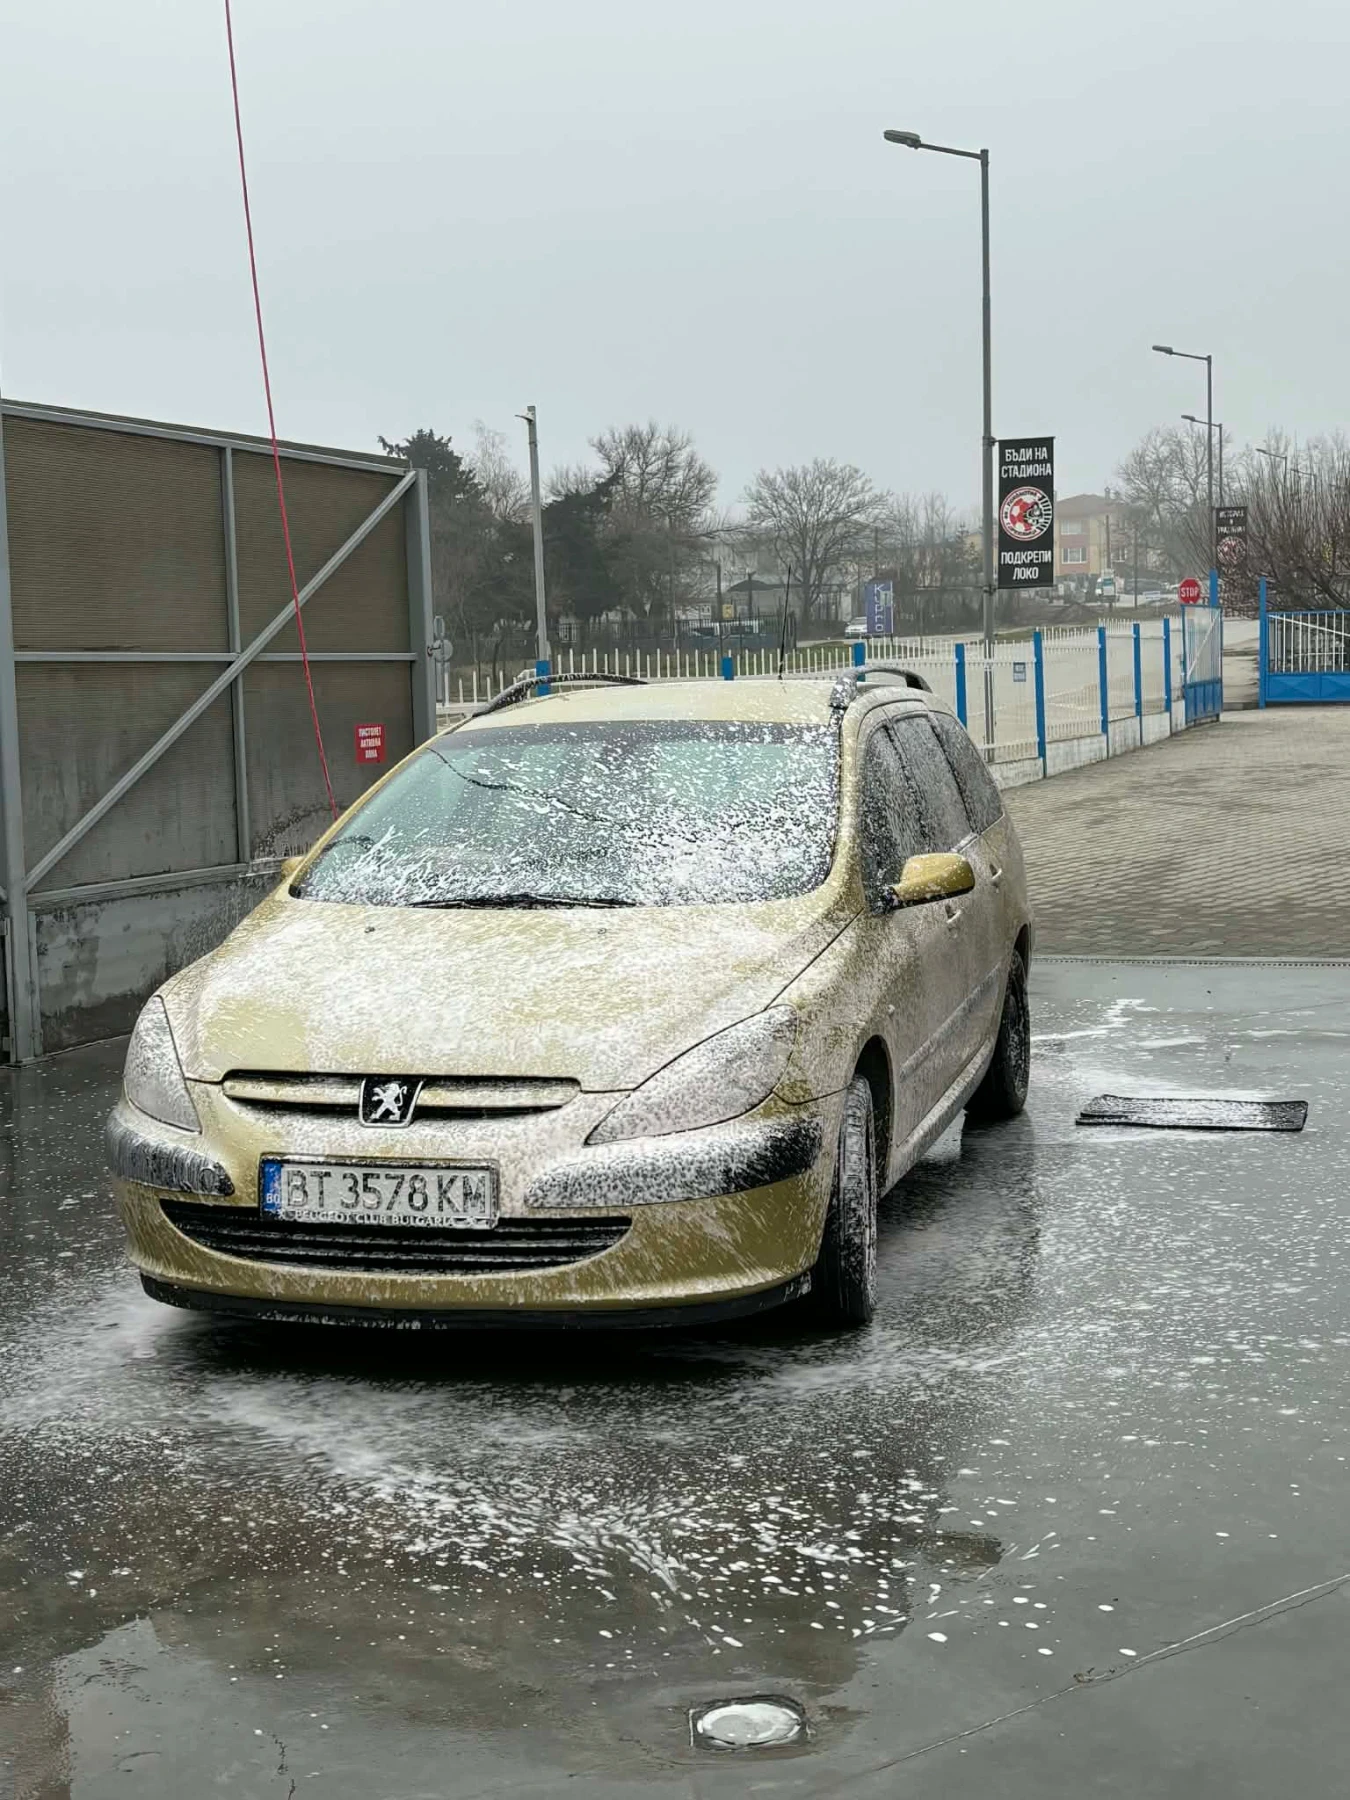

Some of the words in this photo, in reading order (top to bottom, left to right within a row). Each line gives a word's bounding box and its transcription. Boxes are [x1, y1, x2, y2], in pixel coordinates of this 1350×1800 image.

[1005, 449, 1032, 462] БЪДИ
[1034, 447, 1048, 460] НА
[1001, 463, 1052, 478] СТАДИОНА
[1001, 551, 1051, 565] ПОДКРЕПИ
[1012, 567, 1039, 580] ЛОКО
[1180, 587, 1200, 598] STOP
[286, 1169, 332, 1208] BT
[340, 1172, 429, 1212] 3578
[436, 1174, 487, 1214] KM
[295, 1210, 350, 1223] PEUGEOT
[355, 1212, 388, 1225] CLUB
